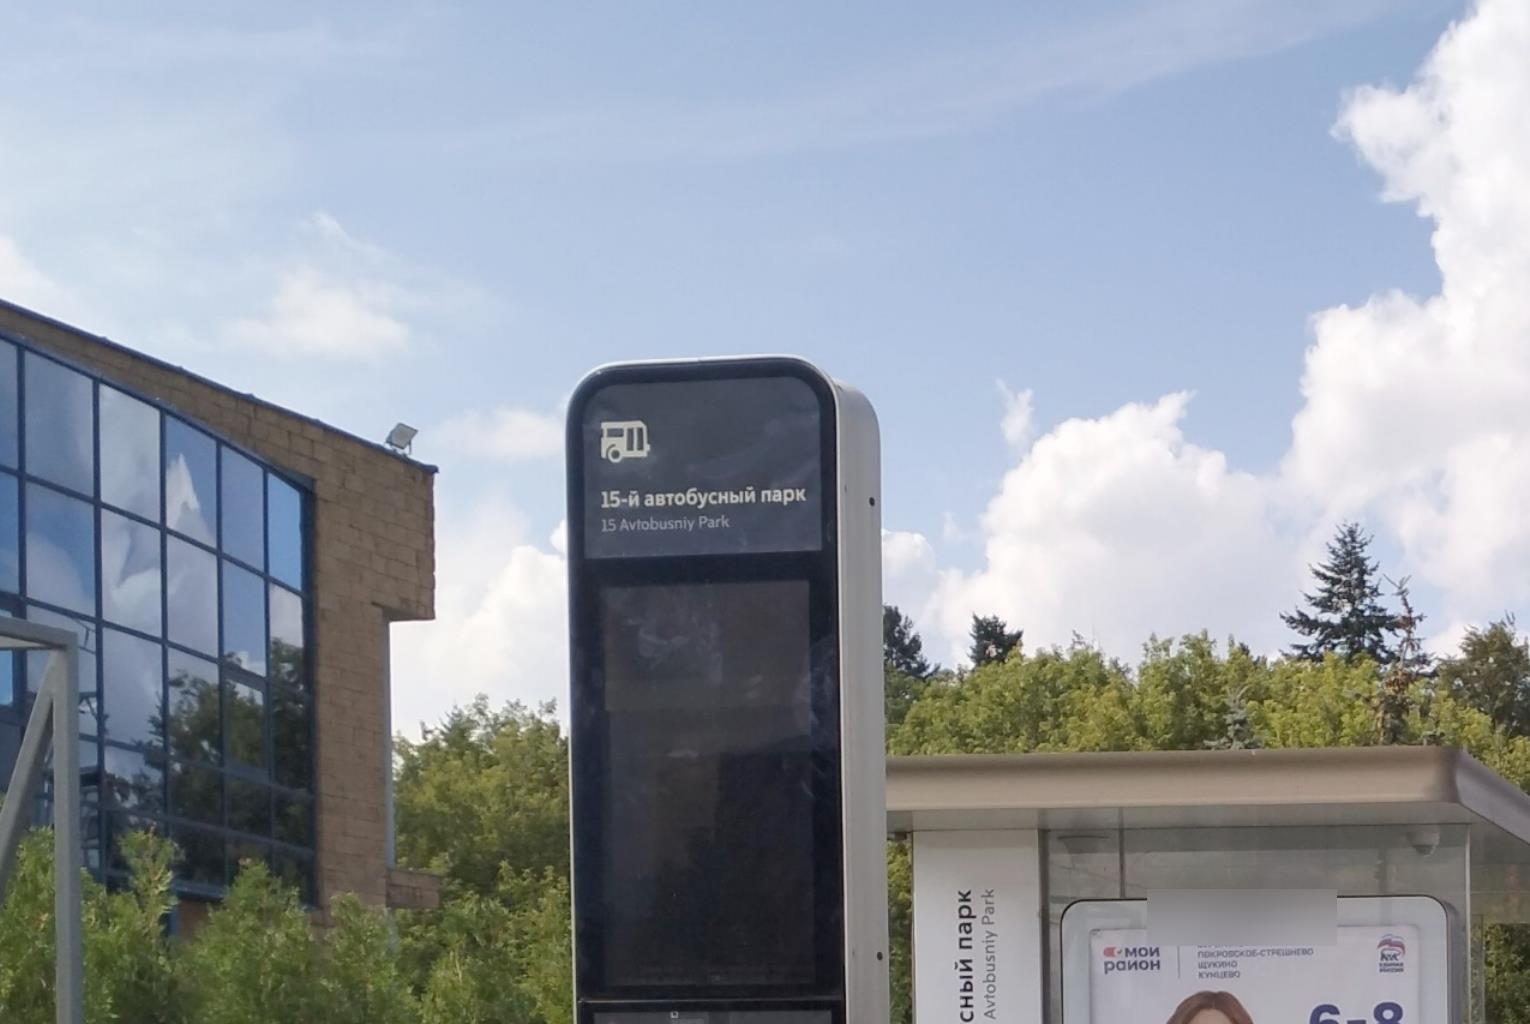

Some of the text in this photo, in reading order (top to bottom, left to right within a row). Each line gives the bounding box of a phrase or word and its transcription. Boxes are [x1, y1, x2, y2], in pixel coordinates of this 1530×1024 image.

[601, 487, 807, 510] 15-й автобусный парк
[601, 515, 730, 532] 15 Avtobusniy Park
[981, 889, 996, 925] Park
[957, 889, 977, 950] парк
[983, 929, 998, 1020] Avtobusniy
[1198, 960, 1238, 969] ЩУКИНО
[1198, 970, 1241, 979] КУНЦЕВО
